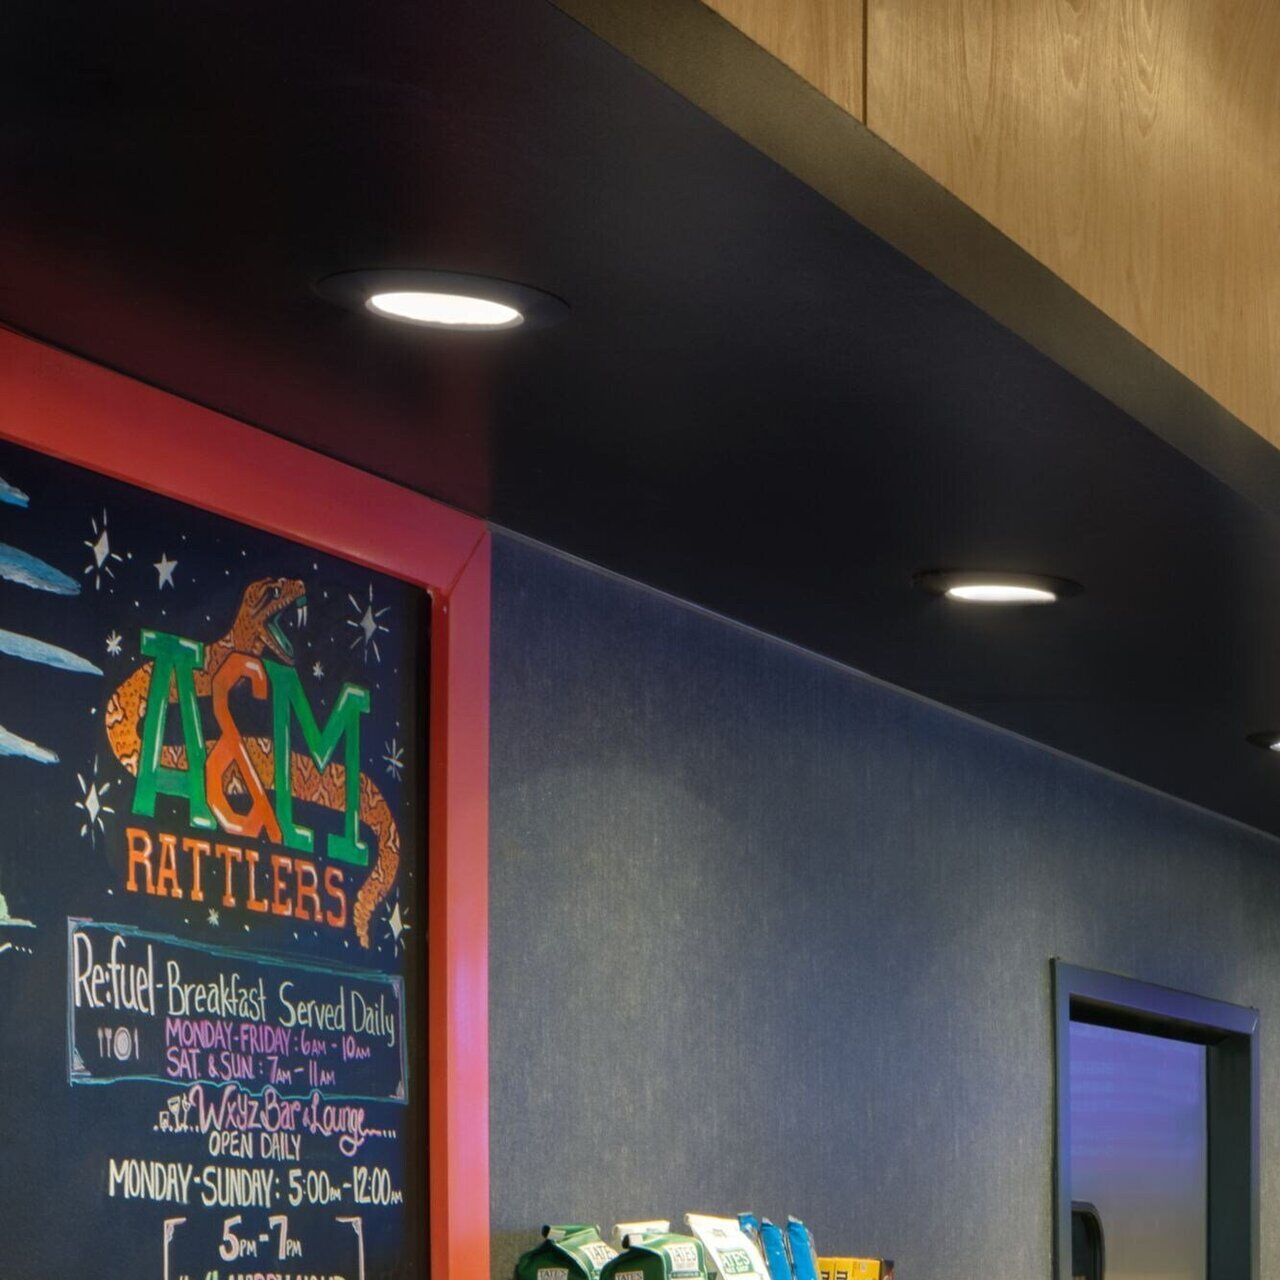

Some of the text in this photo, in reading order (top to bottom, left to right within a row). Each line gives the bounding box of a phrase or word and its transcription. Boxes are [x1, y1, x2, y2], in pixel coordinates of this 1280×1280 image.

[132, 628, 370, 866] A&M
[126, 827, 347, 928] RATTLERS
[166, 960, 266, 1021] Breakfast
[279, 981, 345, 1031] Served
[352, 991, 396, 1047] Daily
[209, 1132, 301, 1161] OPEN DAILY
[262, 1086, 299, 1133] Bar
